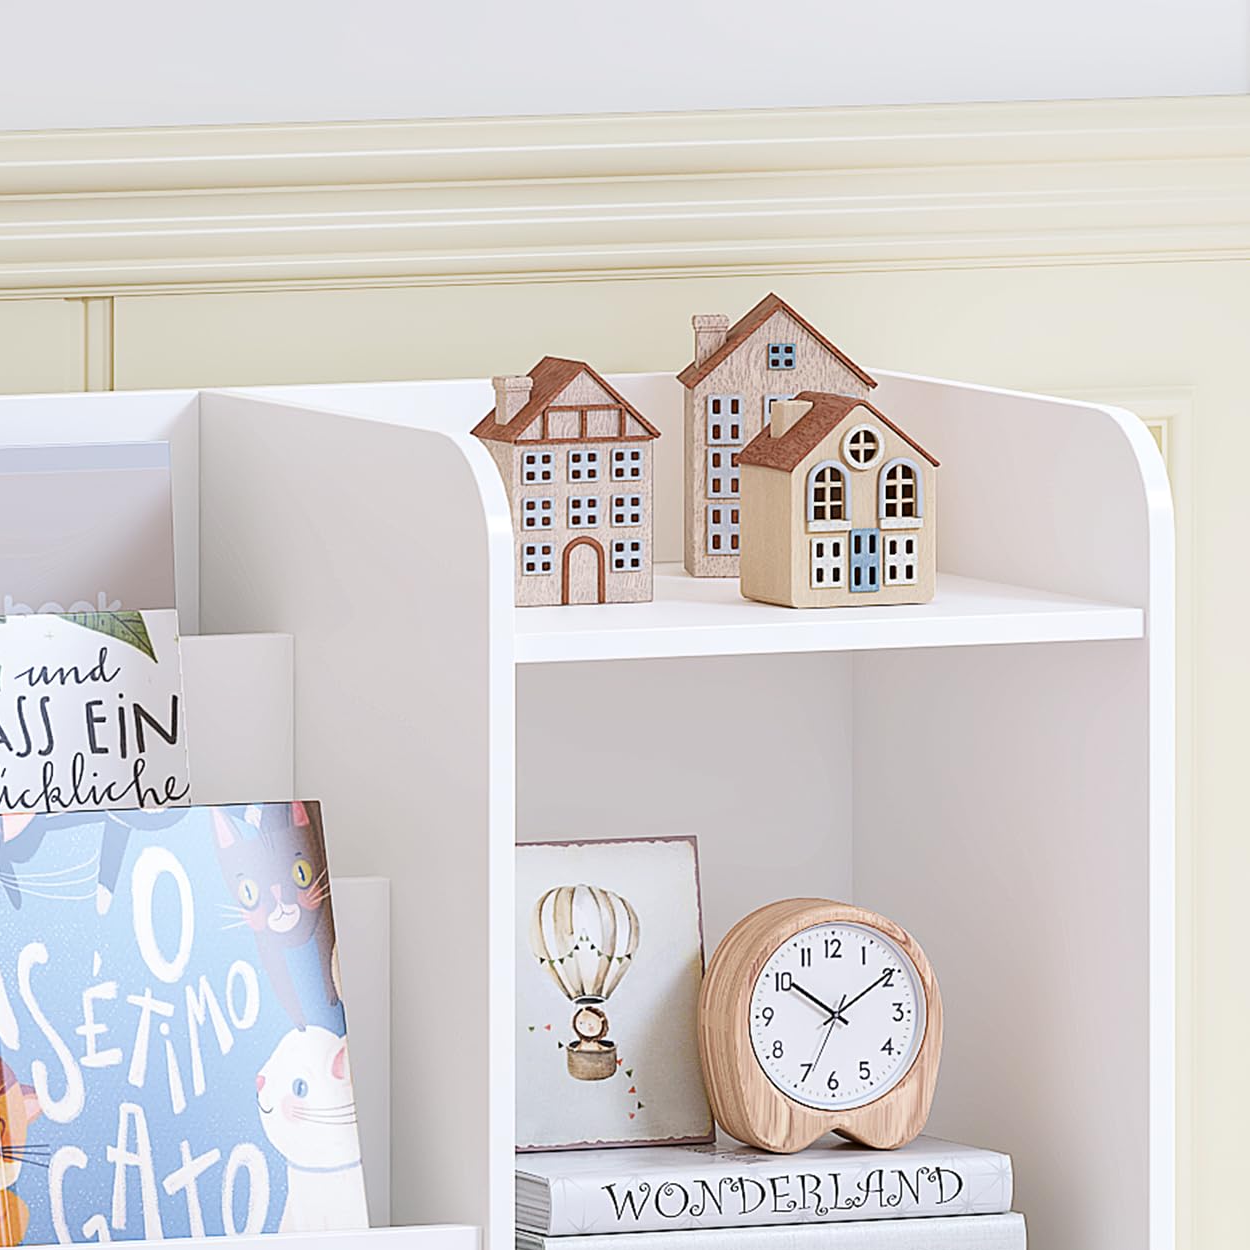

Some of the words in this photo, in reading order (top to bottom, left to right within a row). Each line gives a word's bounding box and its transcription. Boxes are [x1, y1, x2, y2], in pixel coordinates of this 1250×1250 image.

[14, 647, 121, 686] und
[132, 846, 195, 983] O
[801, 947, 811, 967] 11
[824, 939, 842, 958] 12
[861, 946, 866, 965] 1
[775, 971, 792, 992] 10
[762, 1007, 774, 1027] 9
[892, 1002, 904, 1022] 3
[772, 1040, 783, 1059] 8
[880, 1038, 894, 1056] 4
[800, 1063, 813, 1082] 7
[859, 1061, 870, 1080] 5
[827, 1071, 839, 1090] 6
[601, 1166, 963, 1221] WONDERLAND
